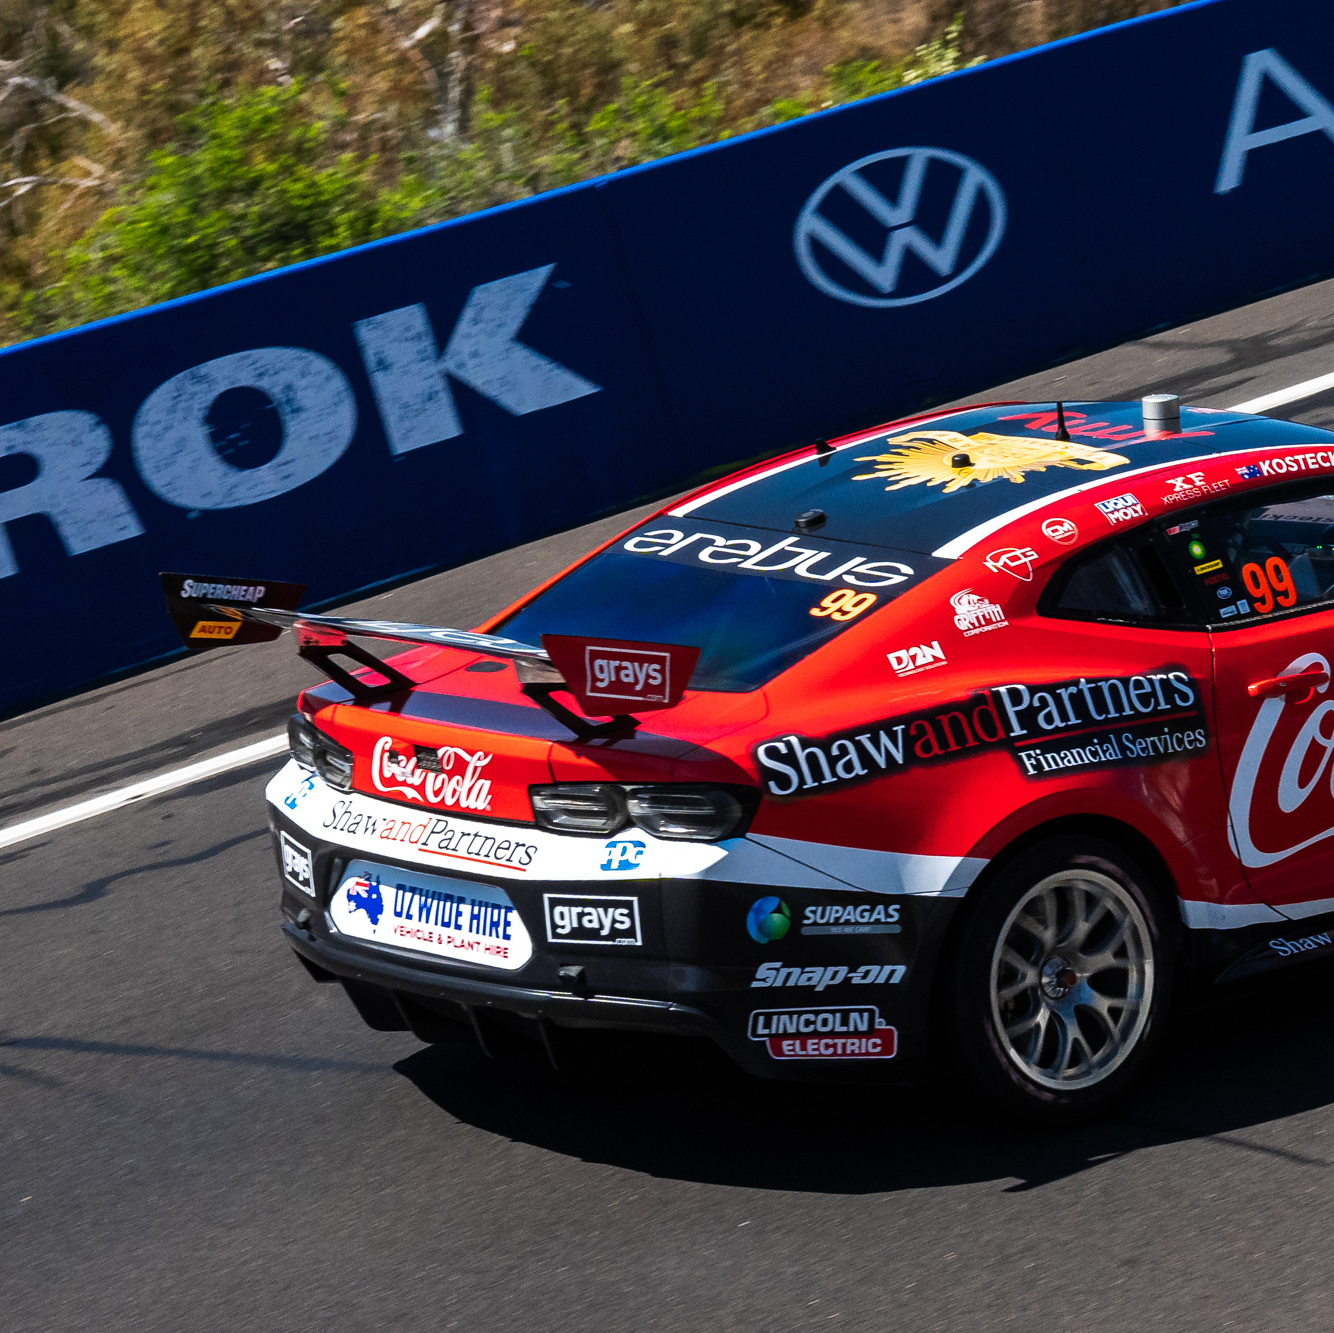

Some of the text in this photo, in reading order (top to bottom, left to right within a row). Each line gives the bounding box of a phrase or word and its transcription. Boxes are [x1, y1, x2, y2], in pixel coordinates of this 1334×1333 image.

[1160, 479, 1231, 505] XPRESS FLEET
[1165, 472, 1207, 492] XF
[1098, 494, 1139, 514] LIQUI
[1108, 504, 1145, 526] MOLY
[623, 529, 915, 587] erebus
[180, 579, 267, 603] SUPERCHEAP
[1242, 556, 1297, 614] 99
[809, 588, 878, 622] 99
[953, 603, 1006, 631] GRIFFITH
[197, 623, 234, 636] AUTO
[594, 659, 662, 691] grays
[1018, 726, 1207, 776] Financial Services
[600, 840, 646, 871] PPG
[393, 882, 517, 941] OZWIDE HIRE
[553, 905, 632, 936] grays
[802, 904, 901, 925] SUPAGAS
[392, 924, 509, 959] VEHICLE & PLANT HIRE
[750, 961, 907, 991] Snap-on
[756, 1012, 870, 1035] LINCOLN
[781, 1038, 883, 1055] ELECTRIC
